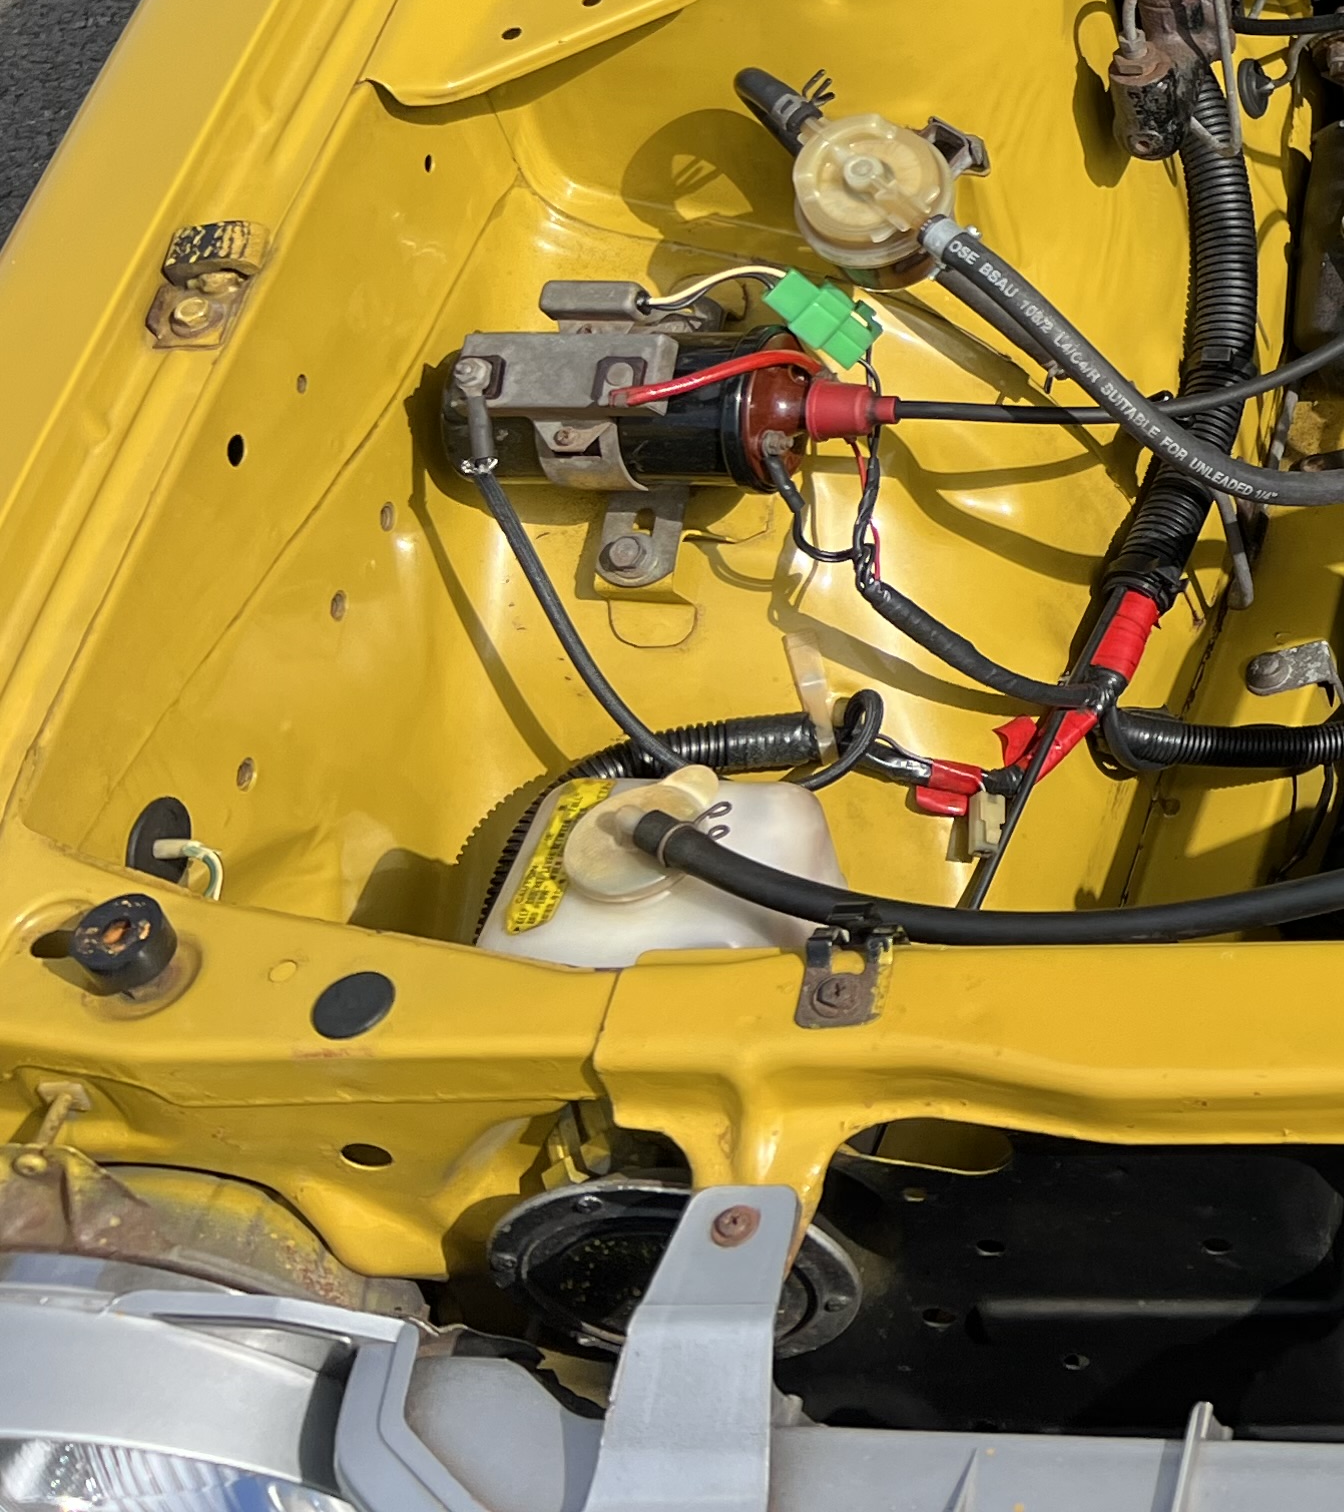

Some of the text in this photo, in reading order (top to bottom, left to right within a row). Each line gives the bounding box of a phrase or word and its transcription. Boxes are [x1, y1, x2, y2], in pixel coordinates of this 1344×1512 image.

[948, 239, 981, 266] OSE
[978, 262, 1019, 299] BSAU
[1099, 381, 1161, 439] SUITABLE
[1159, 436, 1189, 462] FOR
[1188, 456, 1254, 497] UNLEADED
